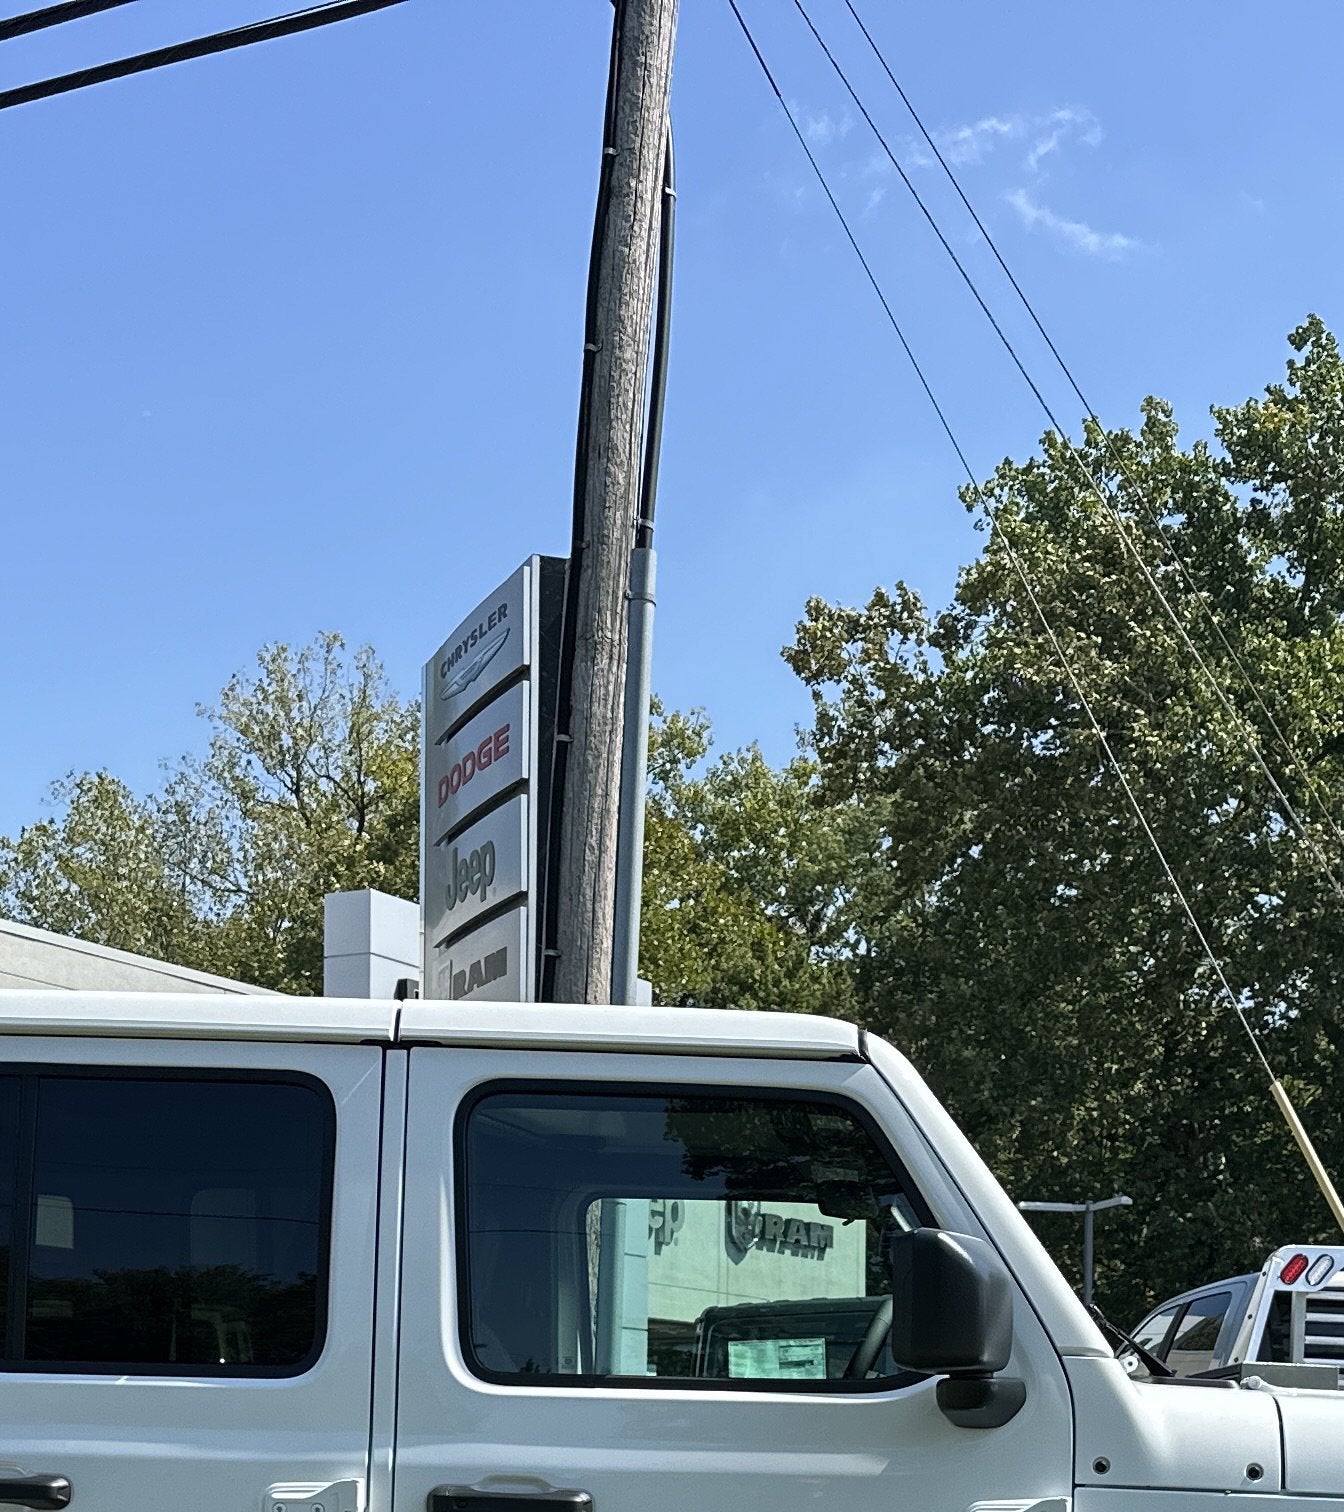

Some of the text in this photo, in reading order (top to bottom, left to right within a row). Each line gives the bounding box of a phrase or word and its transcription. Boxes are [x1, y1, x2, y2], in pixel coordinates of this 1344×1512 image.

[439, 602, 509, 679] CHRYSLER
[437, 723, 511, 808] DODGE
[446, 839, 496, 911] Jeep
[452, 946, 508, 1000] RAM
[761, 1212, 834, 1249] RAM
